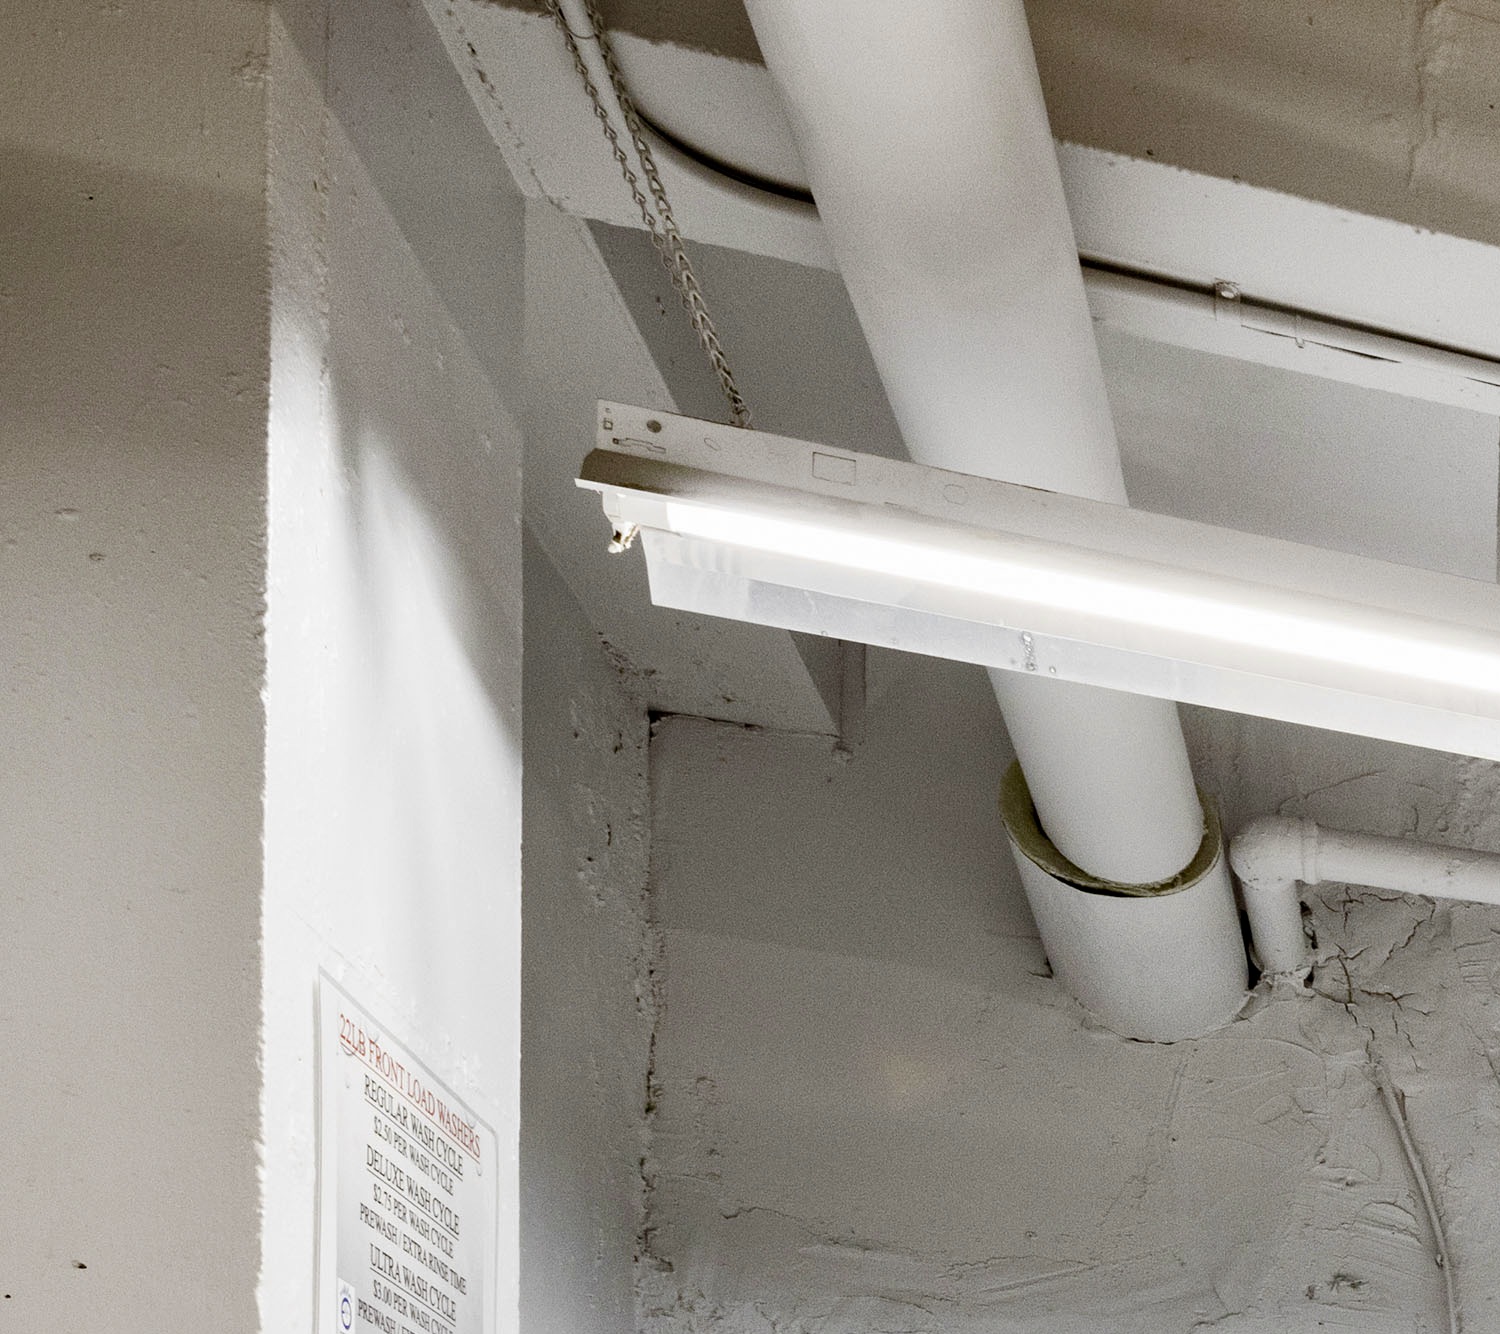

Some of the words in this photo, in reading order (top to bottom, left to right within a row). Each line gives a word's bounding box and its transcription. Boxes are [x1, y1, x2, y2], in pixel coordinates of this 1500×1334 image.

[340, 1014, 365, 1056] 22LB
[368, 1037, 405, 1090] FRONT
[407, 1072, 435, 1116] LOAD
[437, 1099, 481, 1158] WASHERS
[364, 1073, 409, 1130] REGULAR
[411, 1113, 434, 1152] WASH
[437, 1137, 463, 1176] CYCLE
[366, 1144, 404, 1191] DELUXE
[406, 1175, 431, 1213] WASH
[433, 1198, 459, 1235] CYCLE
[394, 1131, 408, 1158] PER
[409, 1144, 429, 1176] WASH
[431, 1164, 454, 1196] CYCLE
[360, 1202, 398, 1245] PREWASH
[403, 1233, 428, 1267] EXTRA
[429, 1252, 448, 1282] RINSE
[450, 1268, 467, 1295] TIME
[394, 1198, 408, 1224] PER
[409, 1210, 430, 1241] WASH
[431, 1227, 454, 1259] CYCLE
[370, 1242, 402, 1284] ULTRA
[402, 1265, 428, 1301] WASH
[430, 1285, 456, 1322] CYCLE
[393, 1292, 408, 1317] PER
[409, 1302, 430, 1332] WASH
